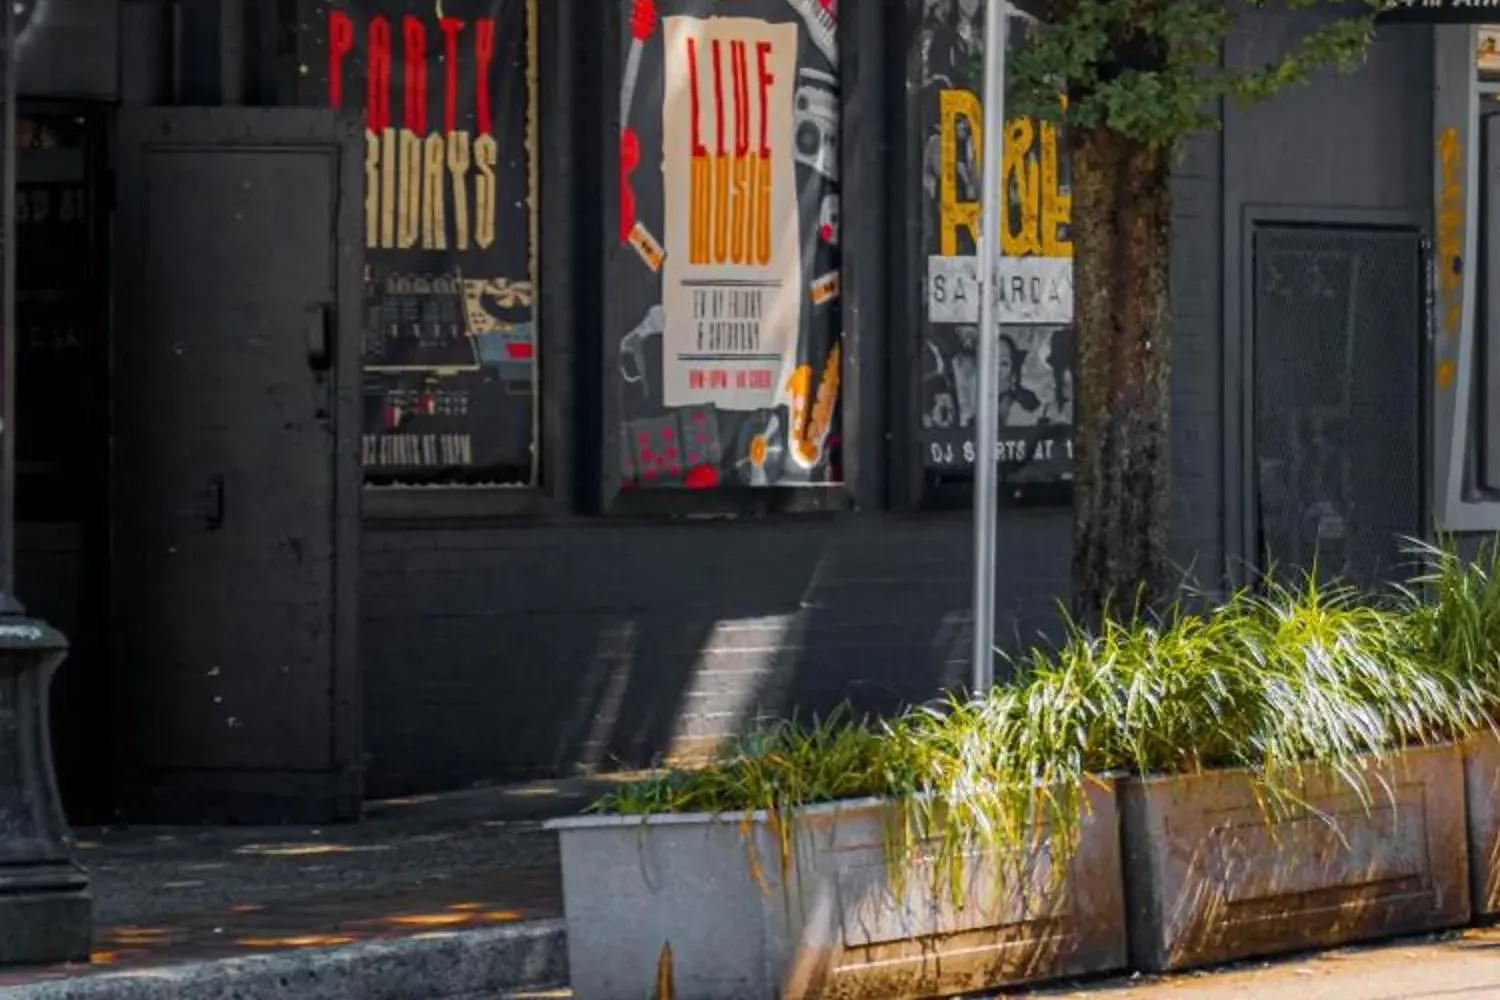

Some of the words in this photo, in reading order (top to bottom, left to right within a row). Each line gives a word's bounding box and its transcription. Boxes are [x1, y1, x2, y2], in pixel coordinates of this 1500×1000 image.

[328, 9, 495, 137] PARTY
[687, 37, 774, 160] LIVE
[364, 127, 498, 250] RIDAYS
[689, 152, 772, 265] MUSIC
[931, 442, 953, 464] DJ
[962, 440, 1027, 463] SRTS
[1033, 439, 1054, 460] AT
